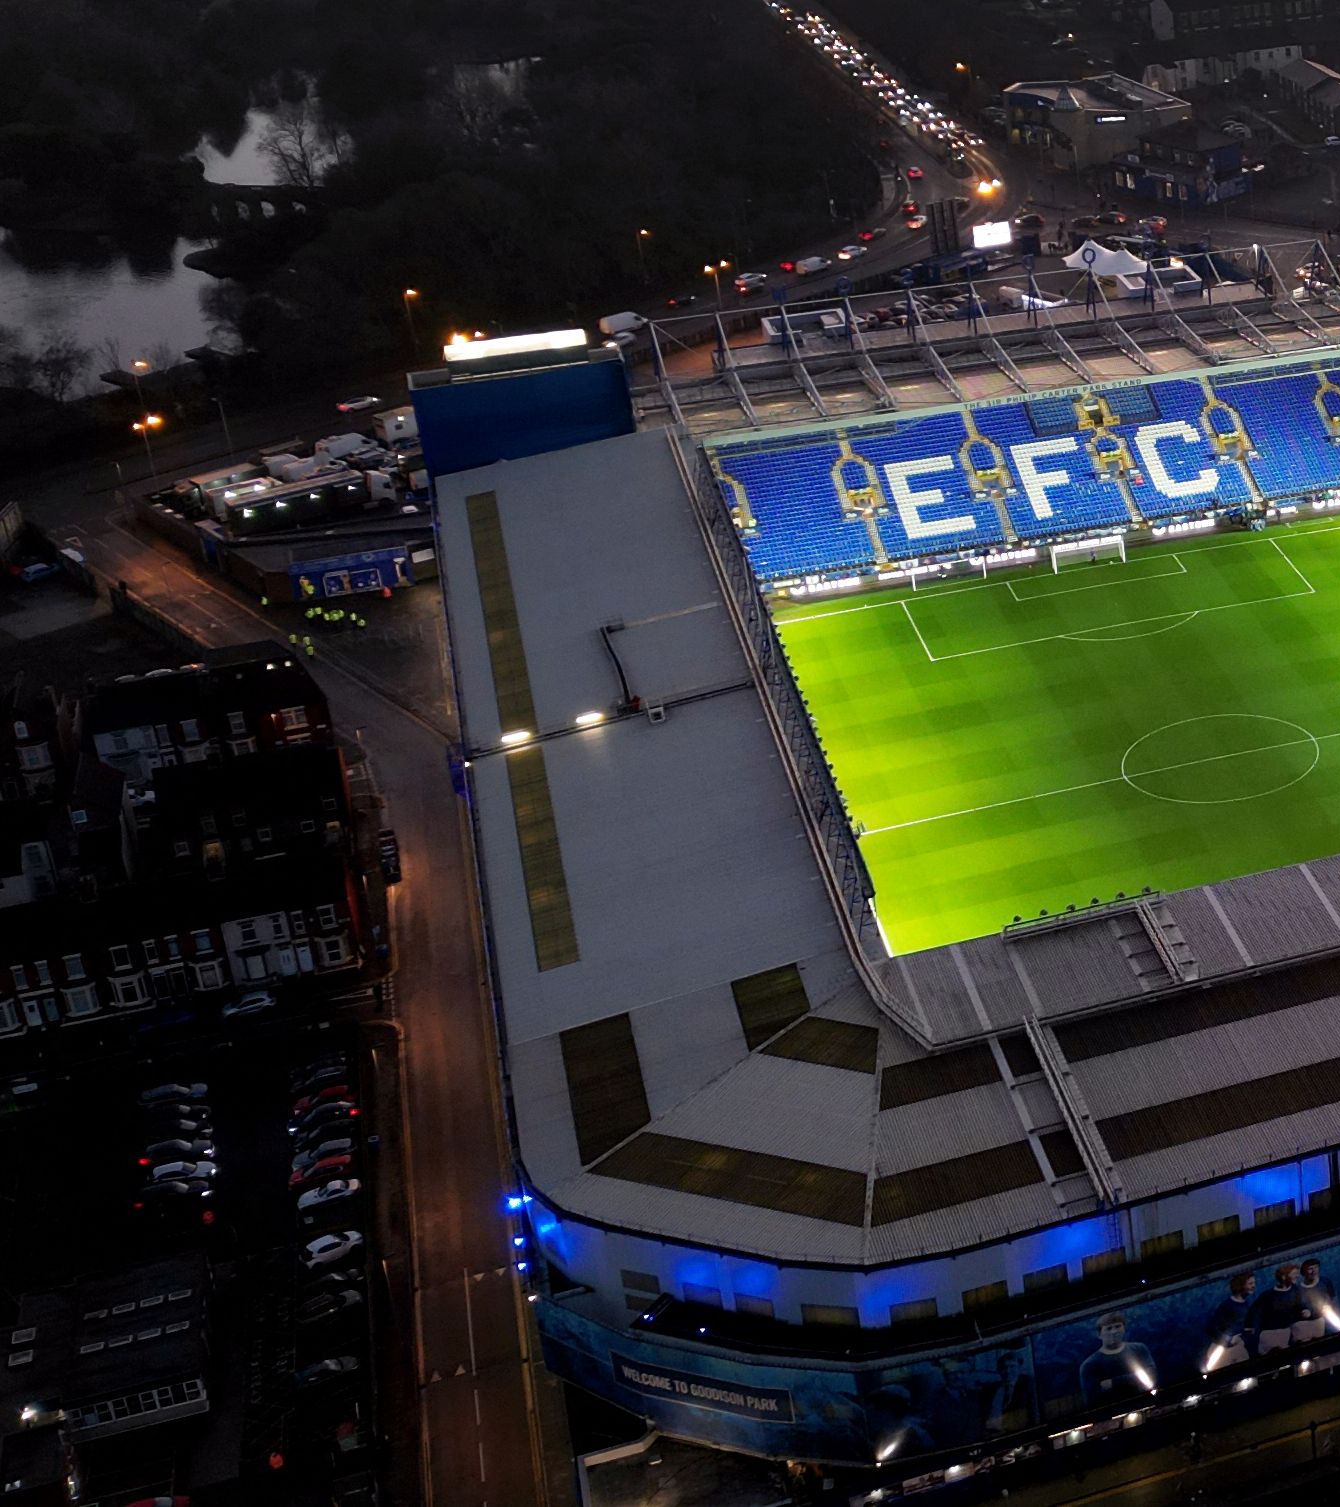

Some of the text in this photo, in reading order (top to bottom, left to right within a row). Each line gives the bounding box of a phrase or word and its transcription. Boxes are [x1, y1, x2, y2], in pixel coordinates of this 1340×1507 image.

[963, 402, 981, 411] THE
[1006, 393, 1037, 404] PHILIP
[1041, 388, 1078, 398] CARTER
[1111, 378, 1142, 389] STAND
[621, 1365, 779, 1412] WELCOME TO GOODISON PARK
